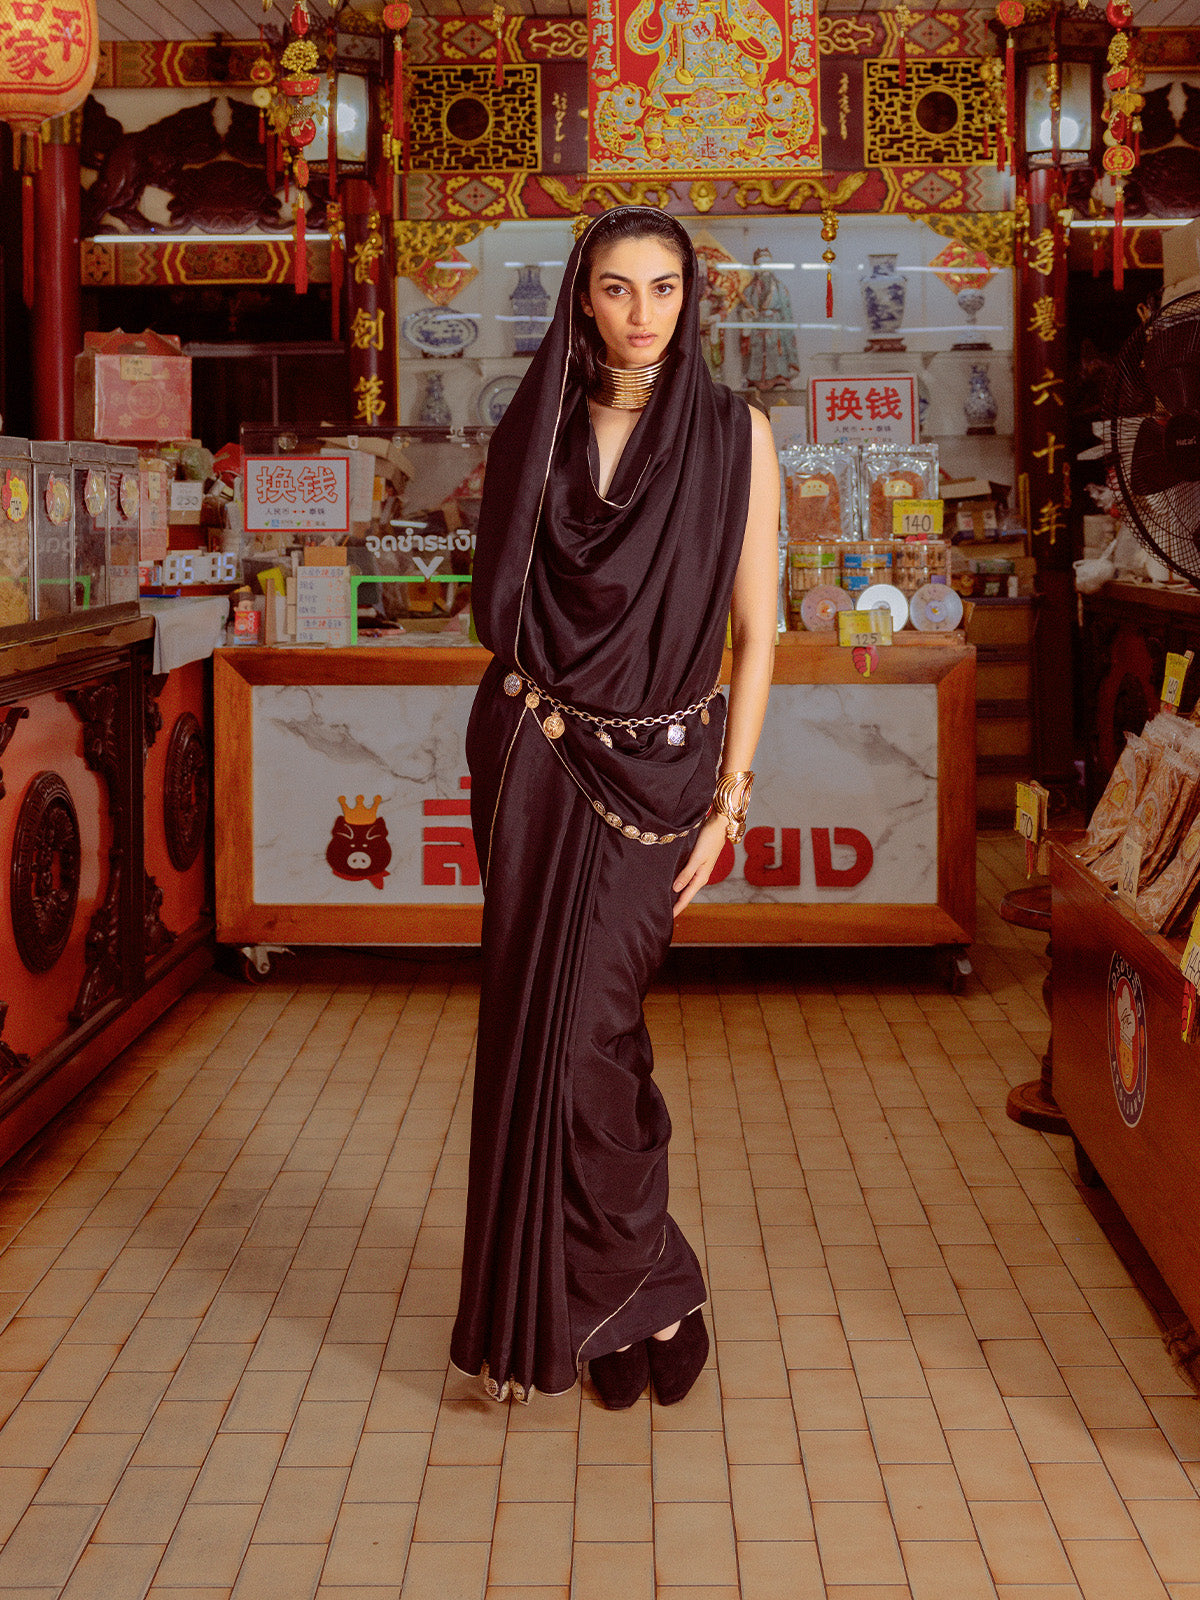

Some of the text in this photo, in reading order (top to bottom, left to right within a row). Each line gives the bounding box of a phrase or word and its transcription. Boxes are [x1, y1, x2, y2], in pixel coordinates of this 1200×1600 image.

[825, 387, 903, 422] 换钱
[256, 466, 339, 504] 换钱
[905, 514, 931, 532] 140
[855, 632, 878, 645] 125
